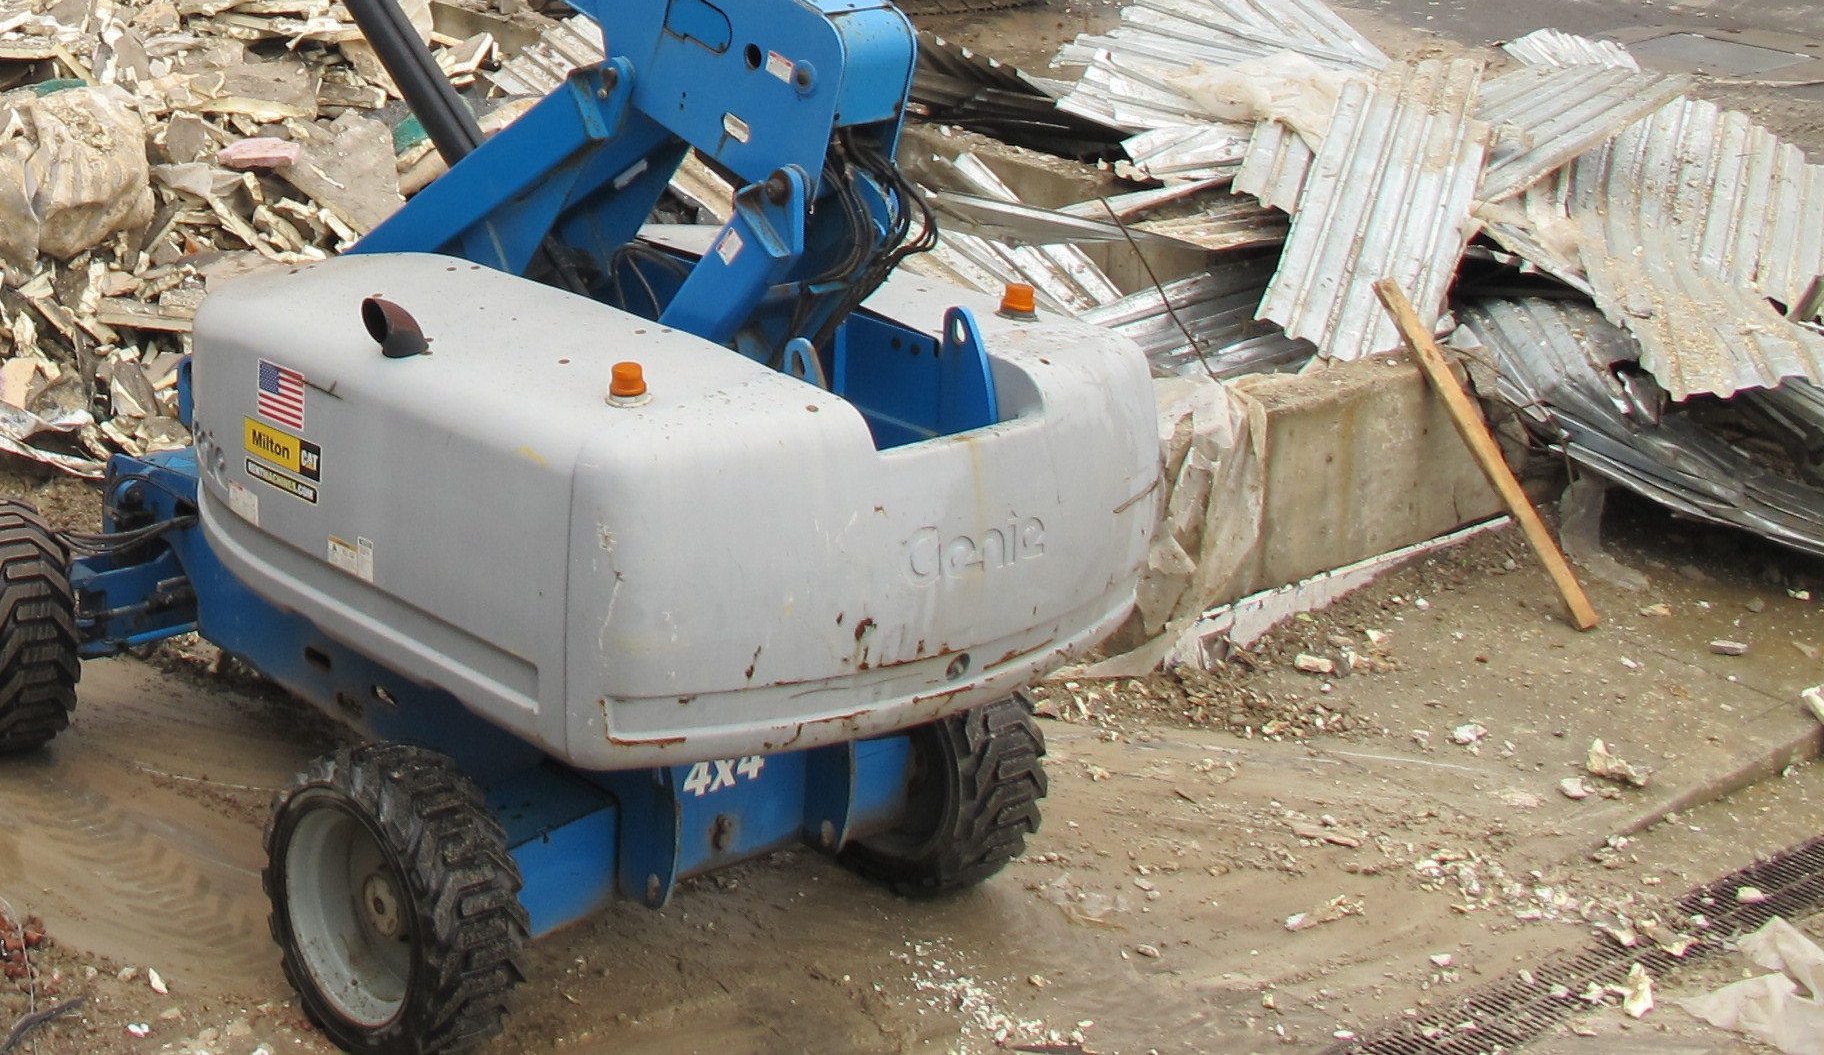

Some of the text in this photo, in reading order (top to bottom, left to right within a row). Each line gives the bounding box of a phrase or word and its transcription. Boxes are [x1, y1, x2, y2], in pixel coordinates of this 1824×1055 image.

[251, 428, 319, 472] Milton CAT
[901, 503, 1046, 588] Genie
